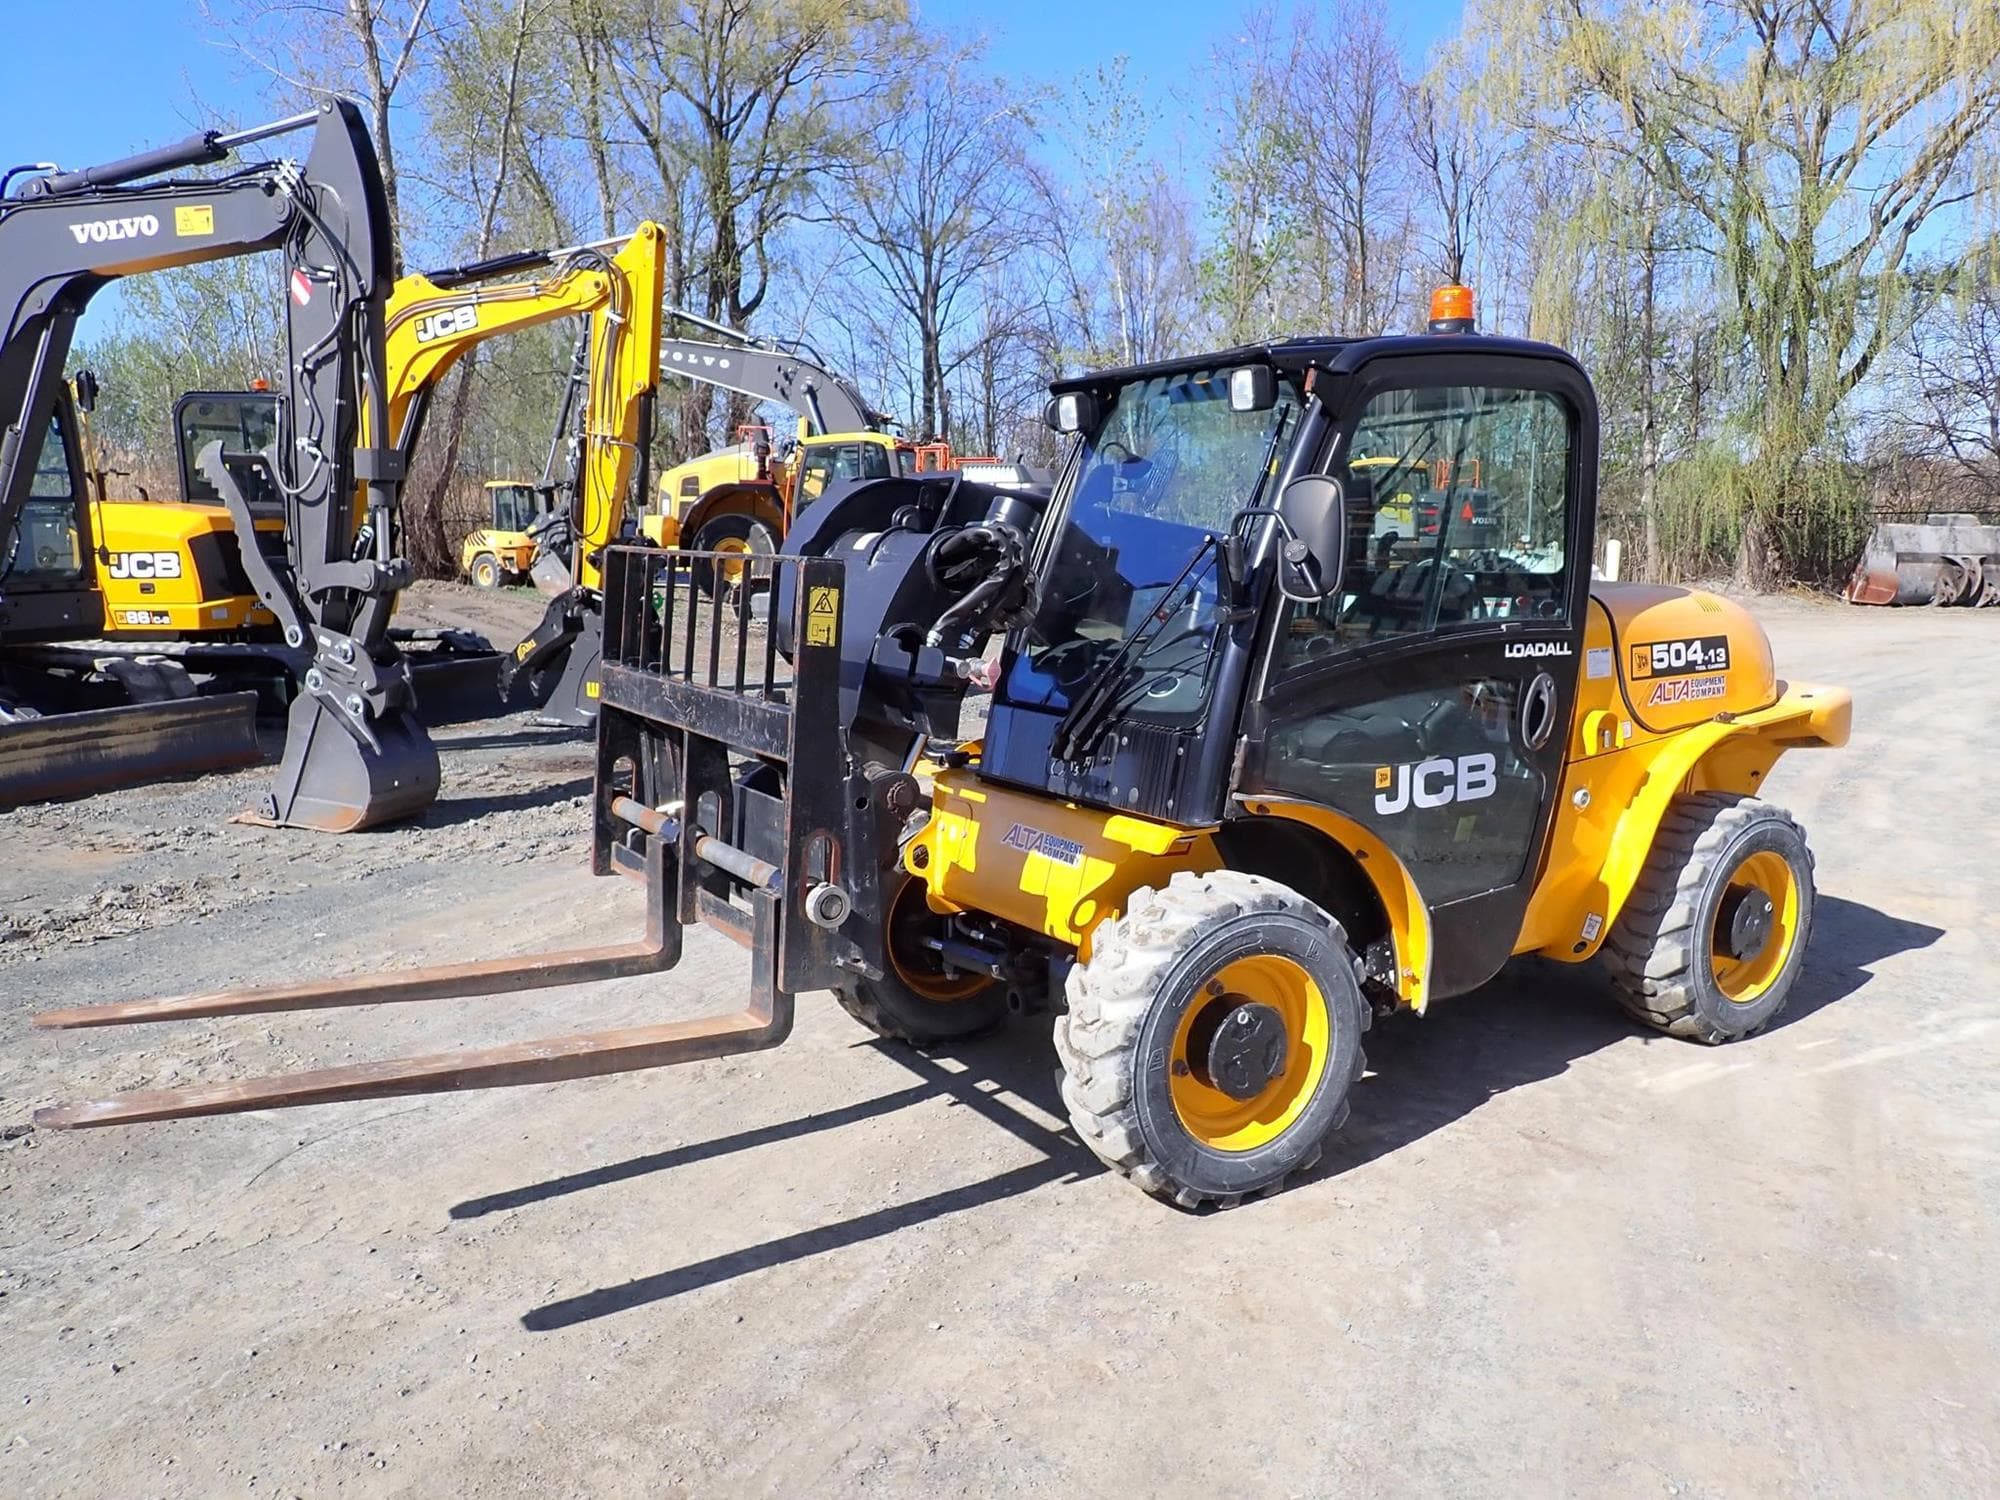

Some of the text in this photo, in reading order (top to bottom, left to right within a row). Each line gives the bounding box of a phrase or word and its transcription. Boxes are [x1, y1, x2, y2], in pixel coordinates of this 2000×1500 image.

[69, 214, 159, 243] VOLVO
[415, 305, 478, 342] JCB
[110, 552, 181, 578] JCB
[1505, 642, 1572, 658] LOADALL
[1649, 680, 1690, 704] ALTA
[1690, 676, 1725, 688] EQUIPMENT
[1690, 686, 1725, 699] COMPANY
[1375, 753, 1496, 815] JCB
[1002, 823, 1045, 852] ALTA
[1044, 834, 1084, 855] EQUIPMENT
